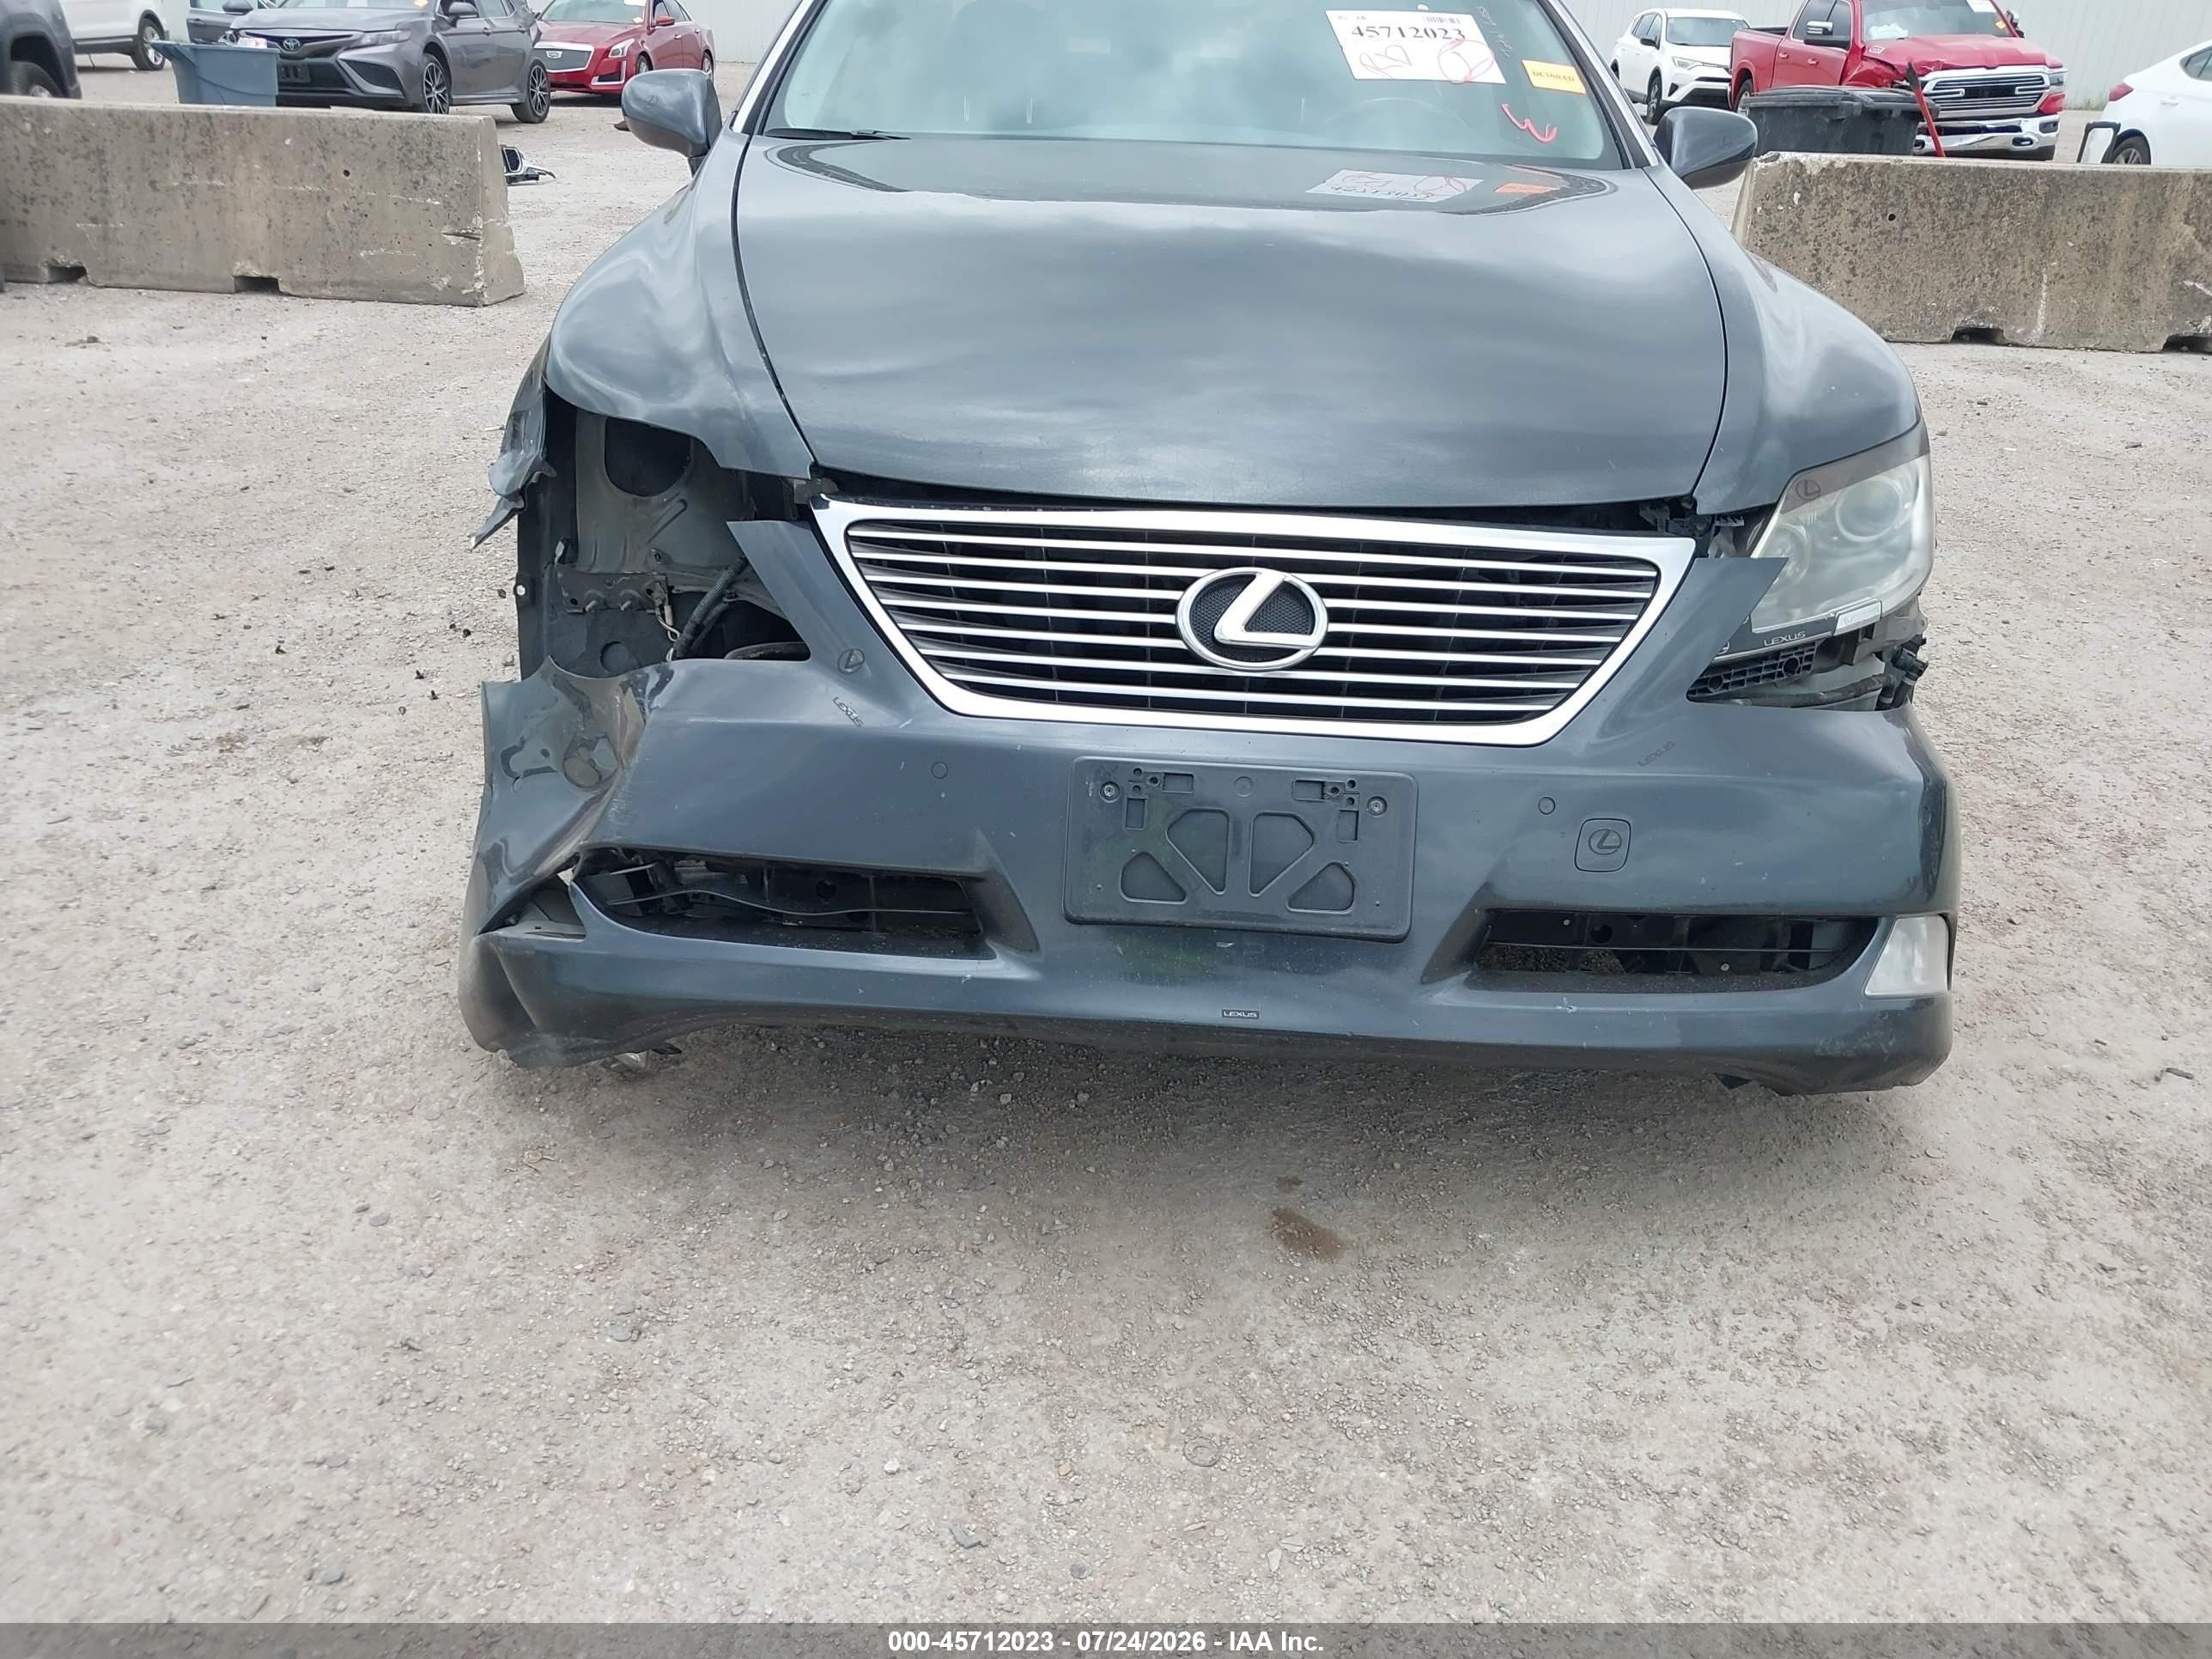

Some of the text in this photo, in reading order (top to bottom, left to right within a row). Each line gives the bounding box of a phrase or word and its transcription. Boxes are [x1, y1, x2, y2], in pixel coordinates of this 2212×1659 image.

[1351, 25, 1466, 41] 45712023
[1763, 630, 1807, 647] LEXUS
[832, 696, 865, 728] LEXUS
[1223, 1010, 1258, 1018] LEXUS
